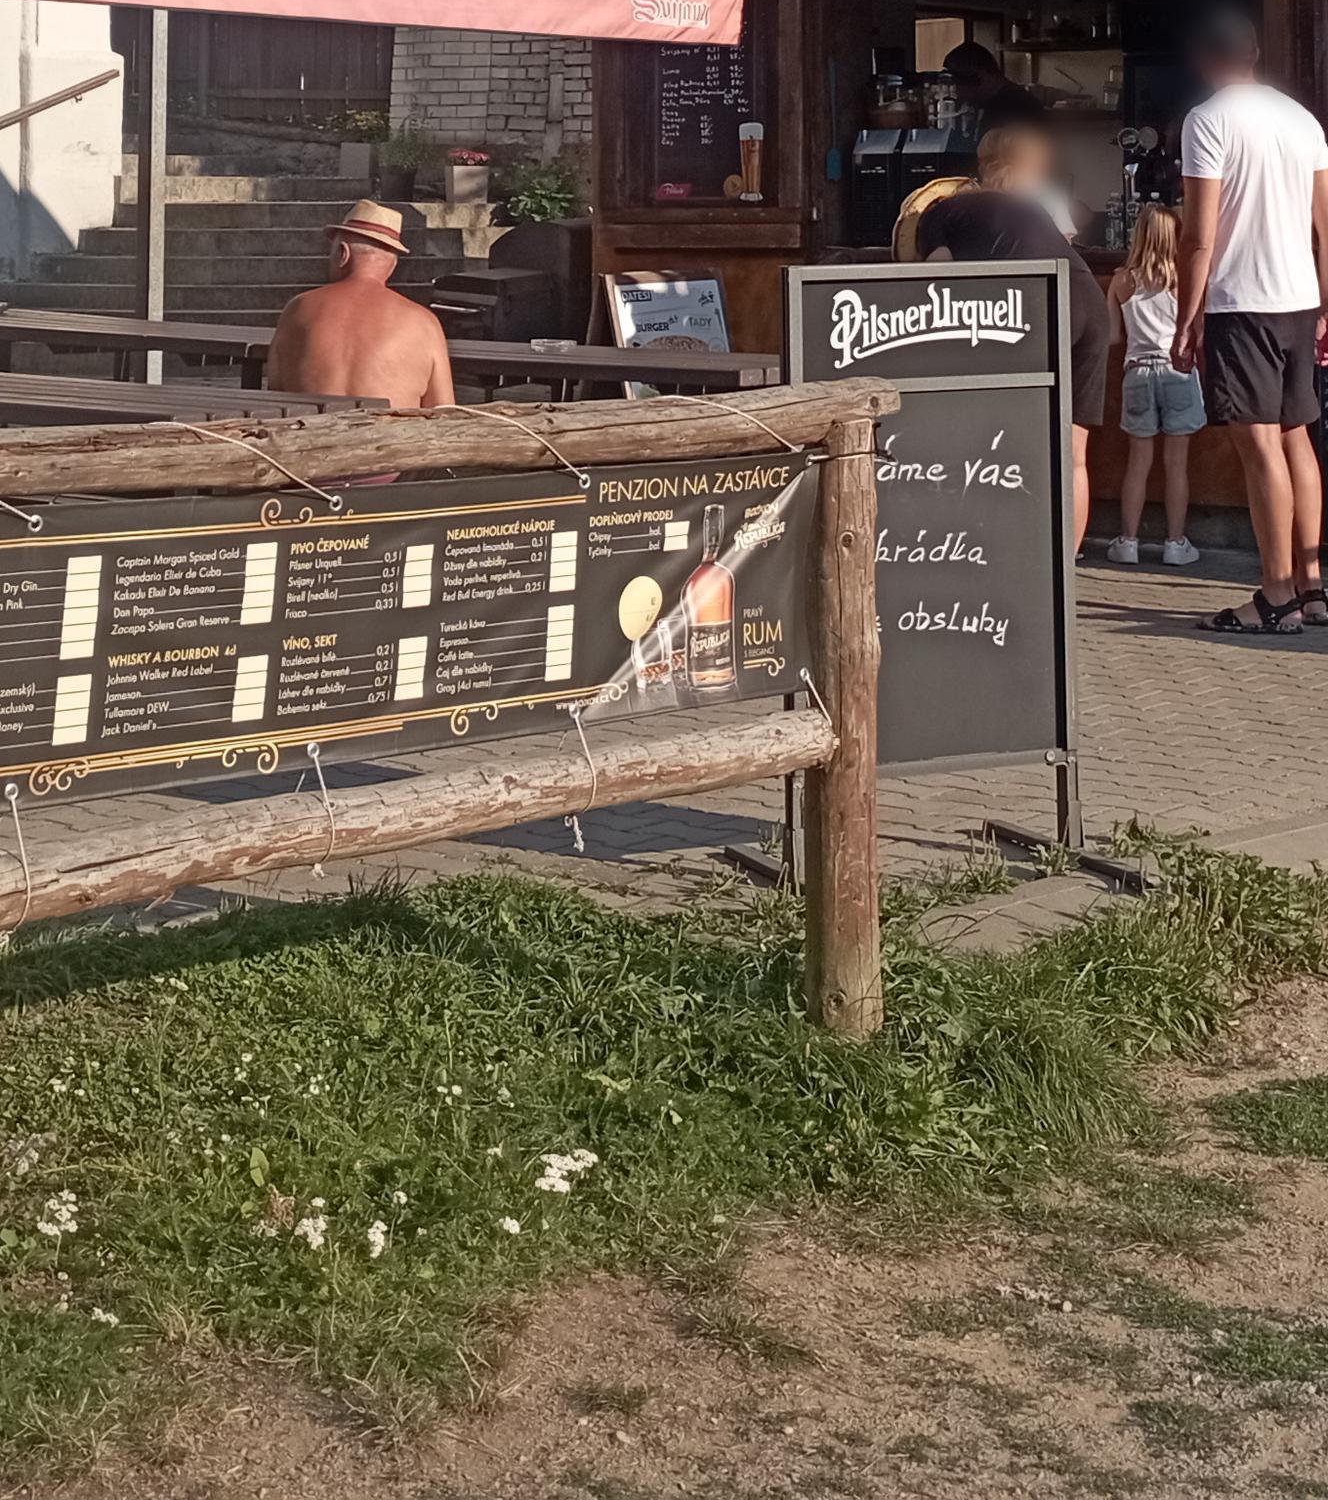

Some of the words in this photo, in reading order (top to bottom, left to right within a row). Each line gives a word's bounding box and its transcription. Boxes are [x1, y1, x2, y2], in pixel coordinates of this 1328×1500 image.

[830, 289, 932, 369] Pilsner
[928, 283, 1024, 347] Urquell
[599, 476, 679, 504] PENZION
[682, 473, 709, 497] NA
[712, 465, 791, 494] ZASTÁVCE
[290, 543, 314, 555] PIVO
[3, 582, 19, 596] Dry
[21, 580, 38, 592] Gin
[6, 598, 23, 610] Pink
[314, 633, 338, 648] SEKT
[743, 618, 783, 647] RUM
[108, 652, 151, 669] WHISKY
[164, 645, 220, 662] BOURBON
